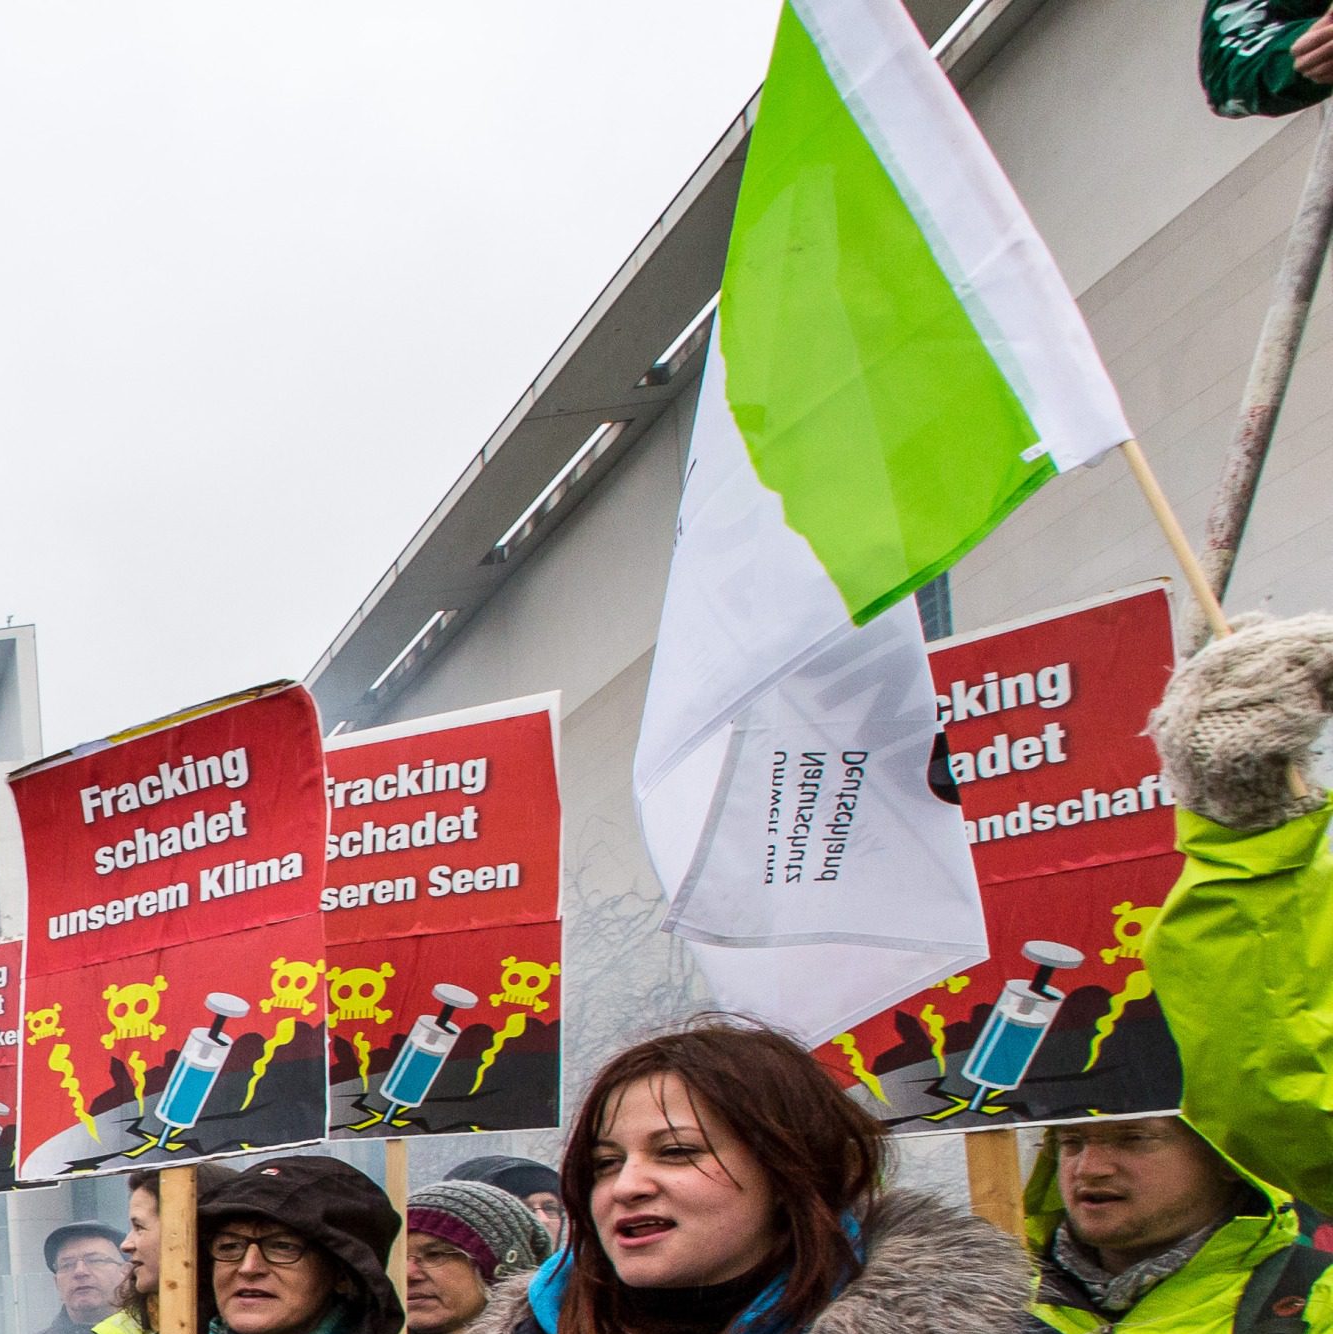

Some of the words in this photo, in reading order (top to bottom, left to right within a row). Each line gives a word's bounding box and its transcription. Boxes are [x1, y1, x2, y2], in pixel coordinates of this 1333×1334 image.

[936, 662, 1071, 726] cking
[80, 747, 249, 824] Fracking
[949, 722, 1068, 785] adet
[94, 800, 248, 875] schadet
[964, 774, 1176, 845] andschaft
[48, 882, 189, 940] unserem
[200, 852, 303, 902] Klima
[319, 876, 417, 912] seren
[428, 863, 521, 897] Seen
